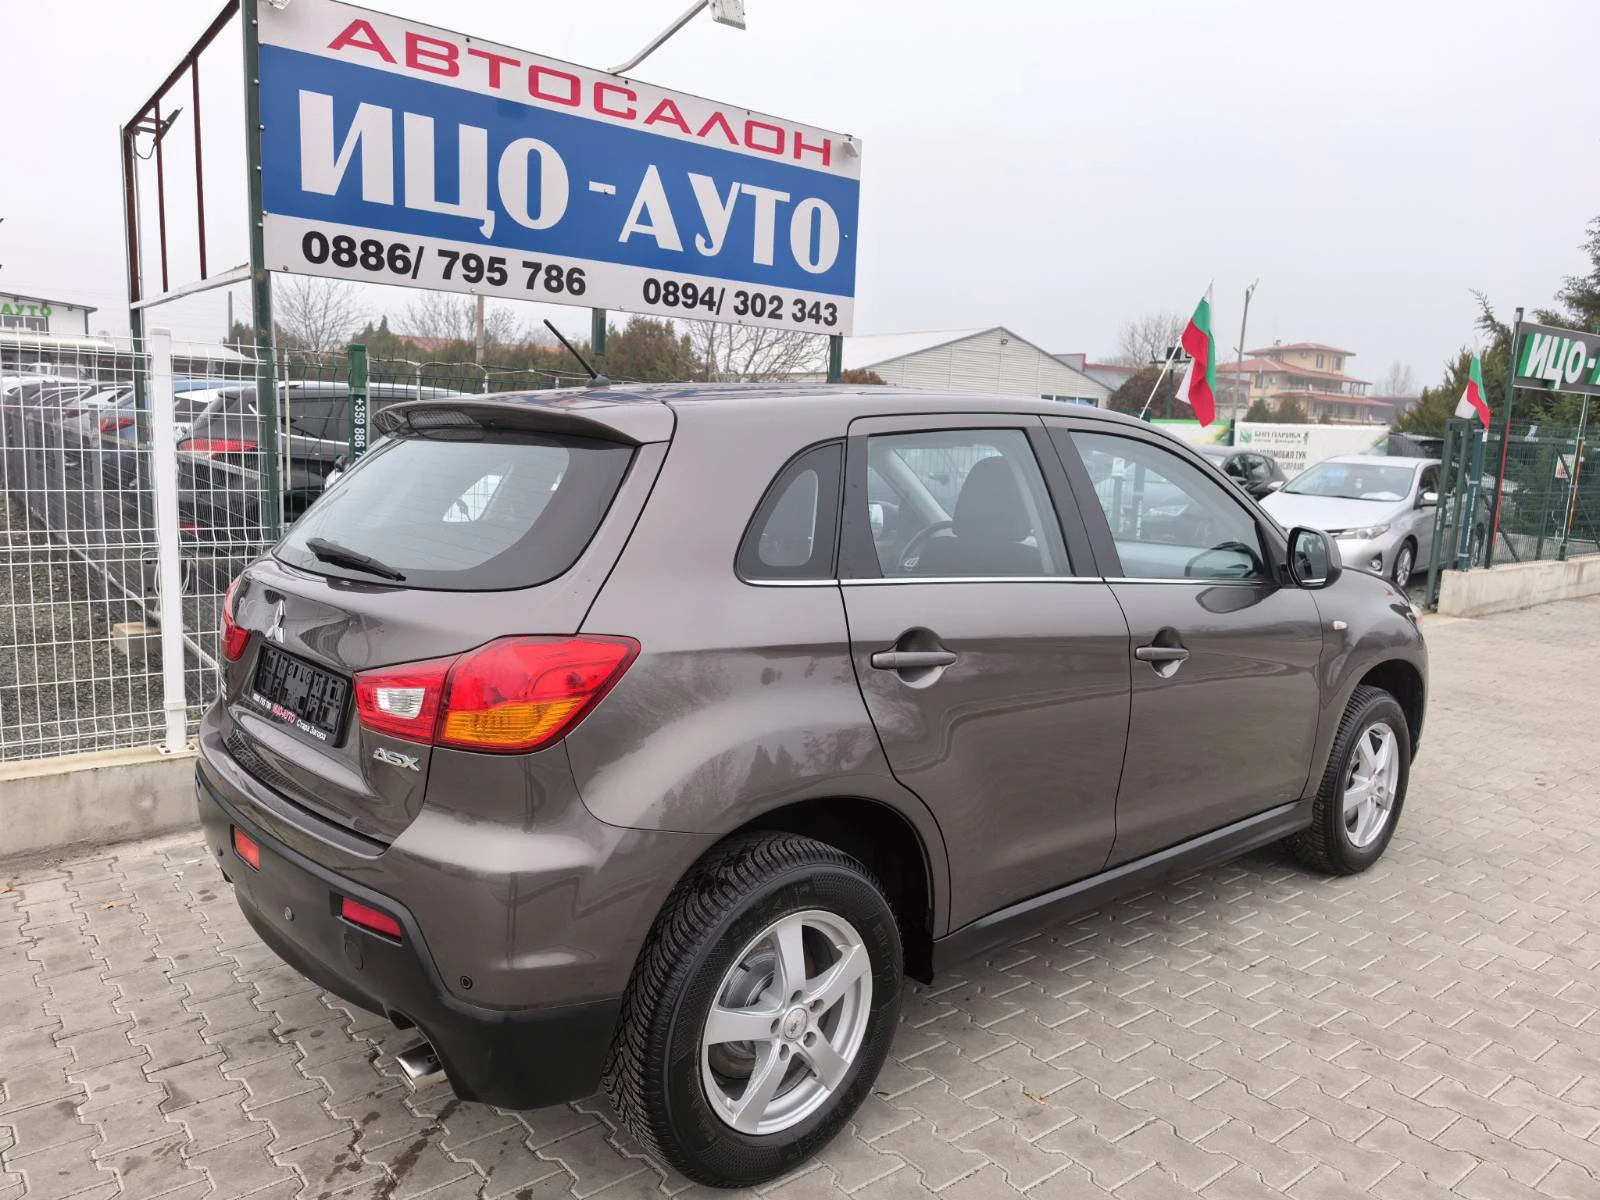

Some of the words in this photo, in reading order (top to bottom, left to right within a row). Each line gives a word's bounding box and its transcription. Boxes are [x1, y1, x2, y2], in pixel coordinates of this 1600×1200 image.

[327, 18, 832, 167] АВТОСАЛОН
[301, 229, 425, 280] 0886/
[437, 249, 509, 287] 795
[521, 261, 587, 297] 786
[1, 303, 52, 317] АУТО
[642, 277, 726, 316] 0894/
[733, 290, 784, 322] 302
[791, 297, 839, 327] 343
[1518, 332, 1600, 390] ИЦО-
[354, 398, 366, 425] +359
[354, 427, 366, 448] 886
[373, 747, 420, 772] ASX
